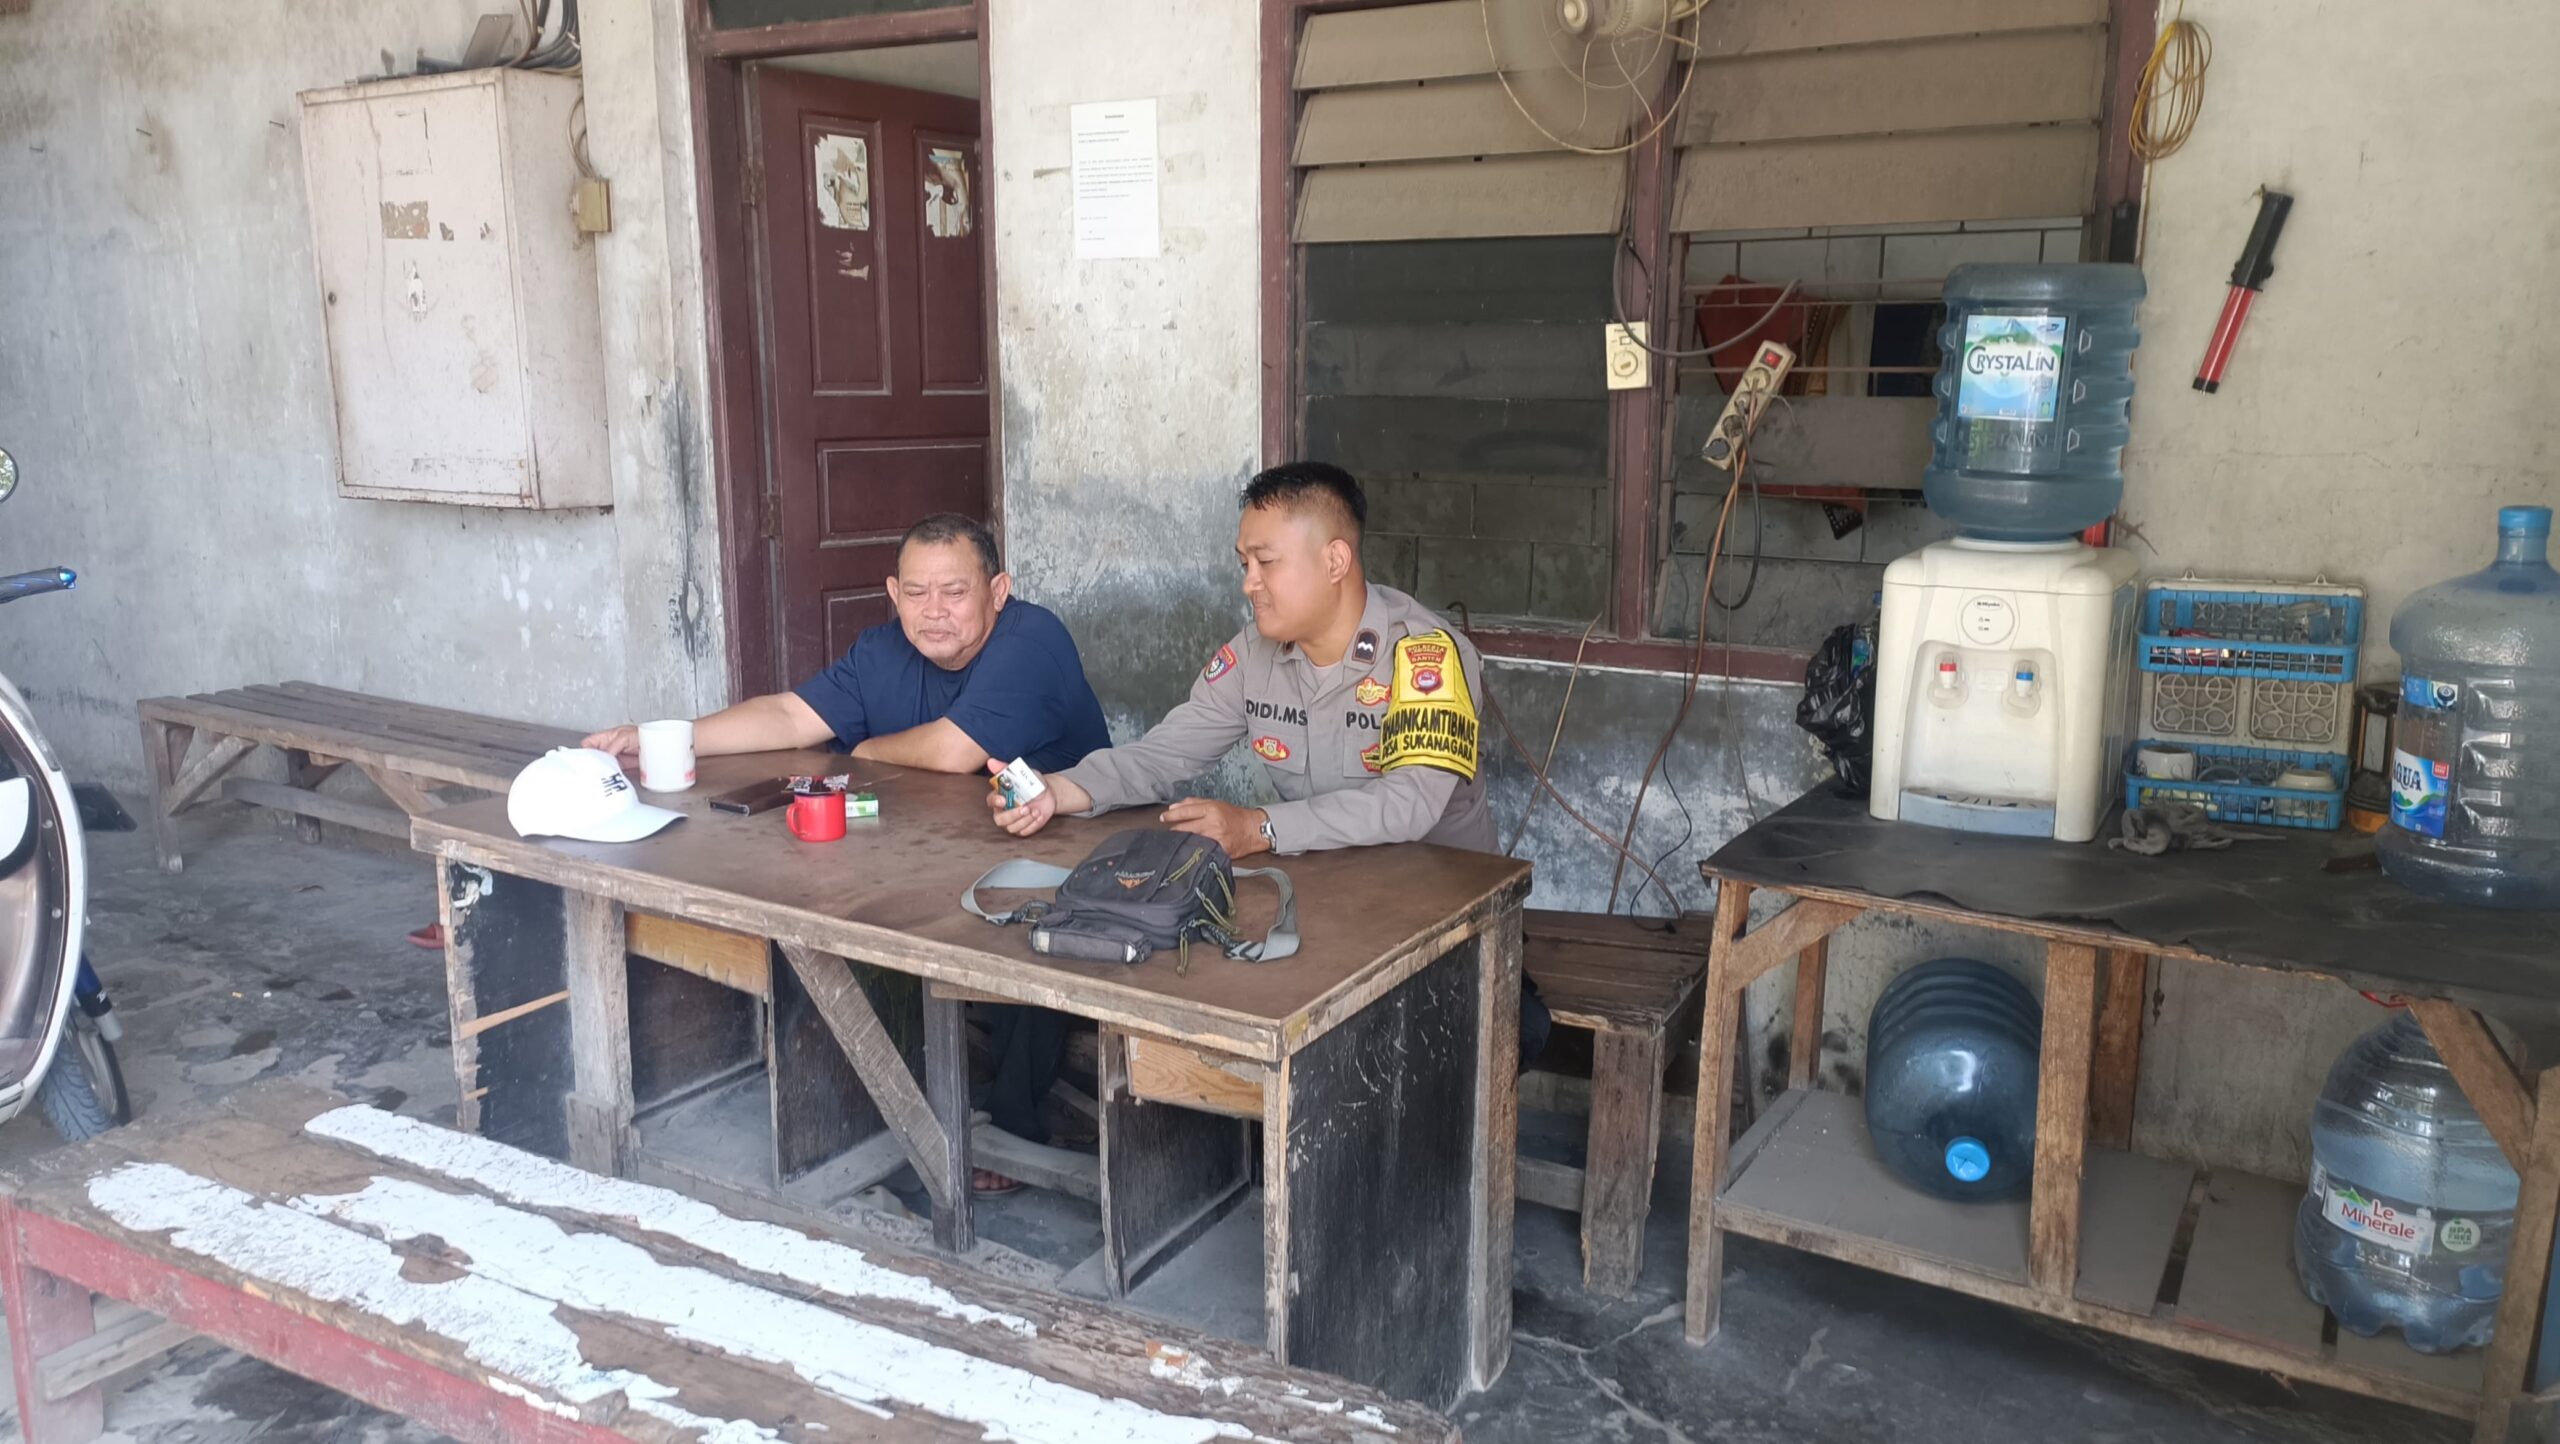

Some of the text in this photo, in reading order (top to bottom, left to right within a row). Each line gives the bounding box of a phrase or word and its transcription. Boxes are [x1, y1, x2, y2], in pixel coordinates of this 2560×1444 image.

[1245, 699, 1308, 726] DIDI.MS
[1346, 711, 1386, 730] POL
[1382, 737, 1399, 760] DESA
[1403, 733, 1473, 763] SUKANAGARA
[2341, 1203, 2415, 1239] Minerale
[2373, 1201, 2394, 1220] Le
